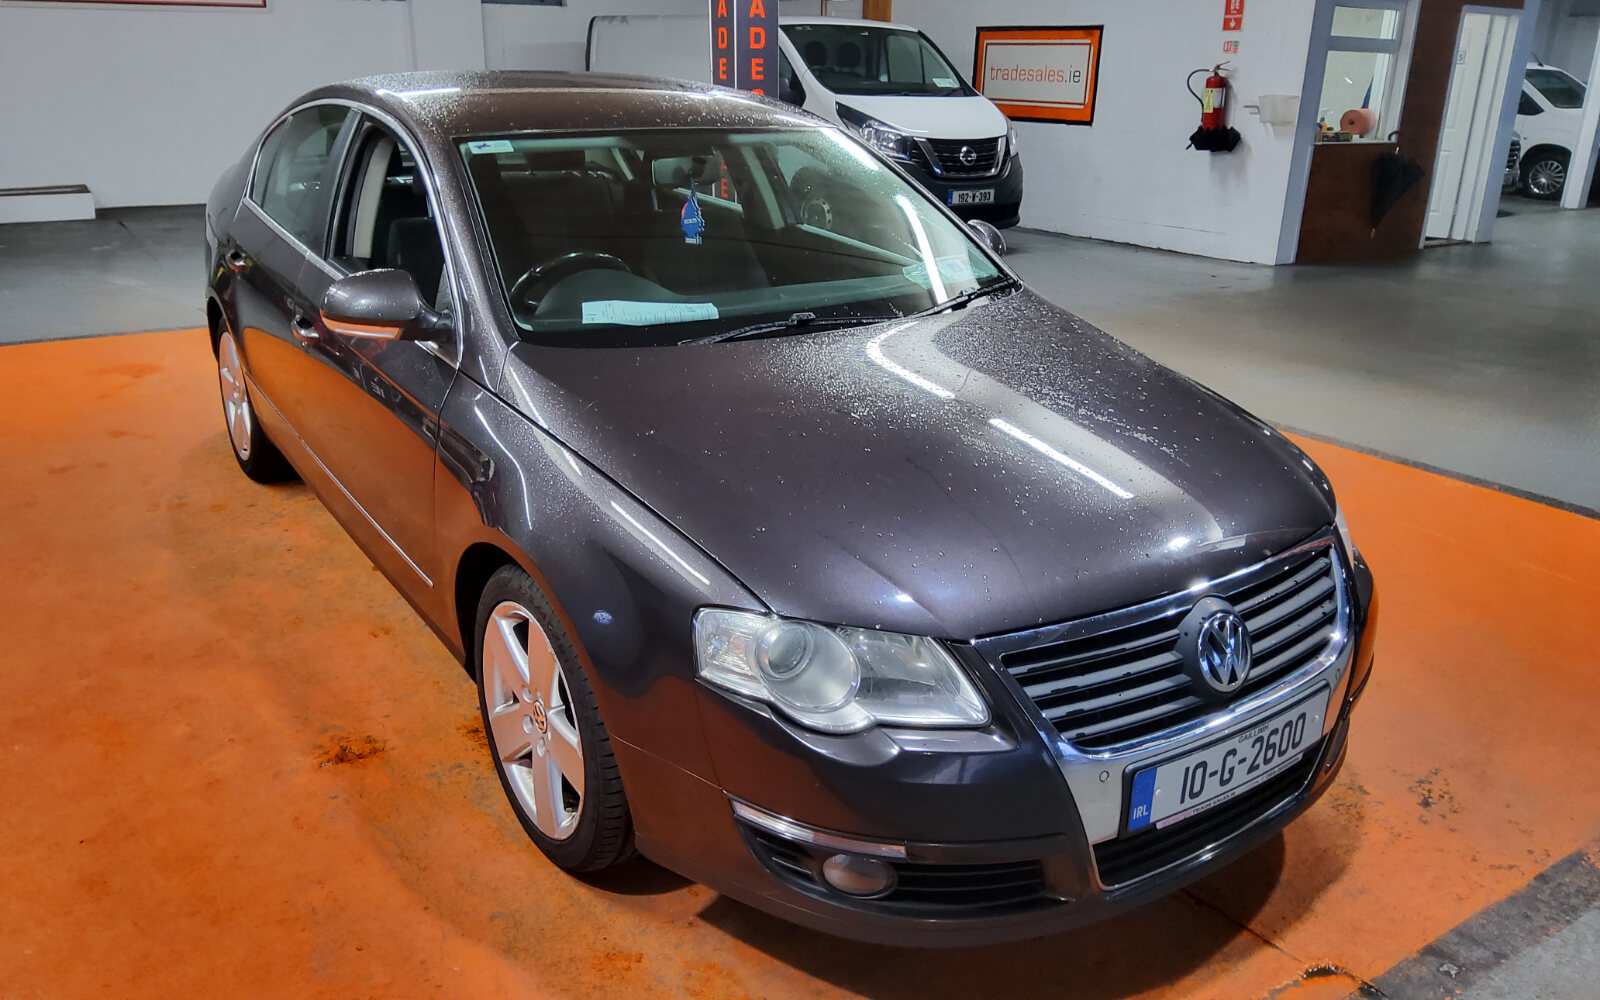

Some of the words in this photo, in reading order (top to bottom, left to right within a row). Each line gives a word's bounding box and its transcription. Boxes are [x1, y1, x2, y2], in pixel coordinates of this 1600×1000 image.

[990, 64, 1081, 83] tradesales.ie
[1180, 711, 1306, 805] 10-G-2600
[1133, 804, 1149, 820] IRL
